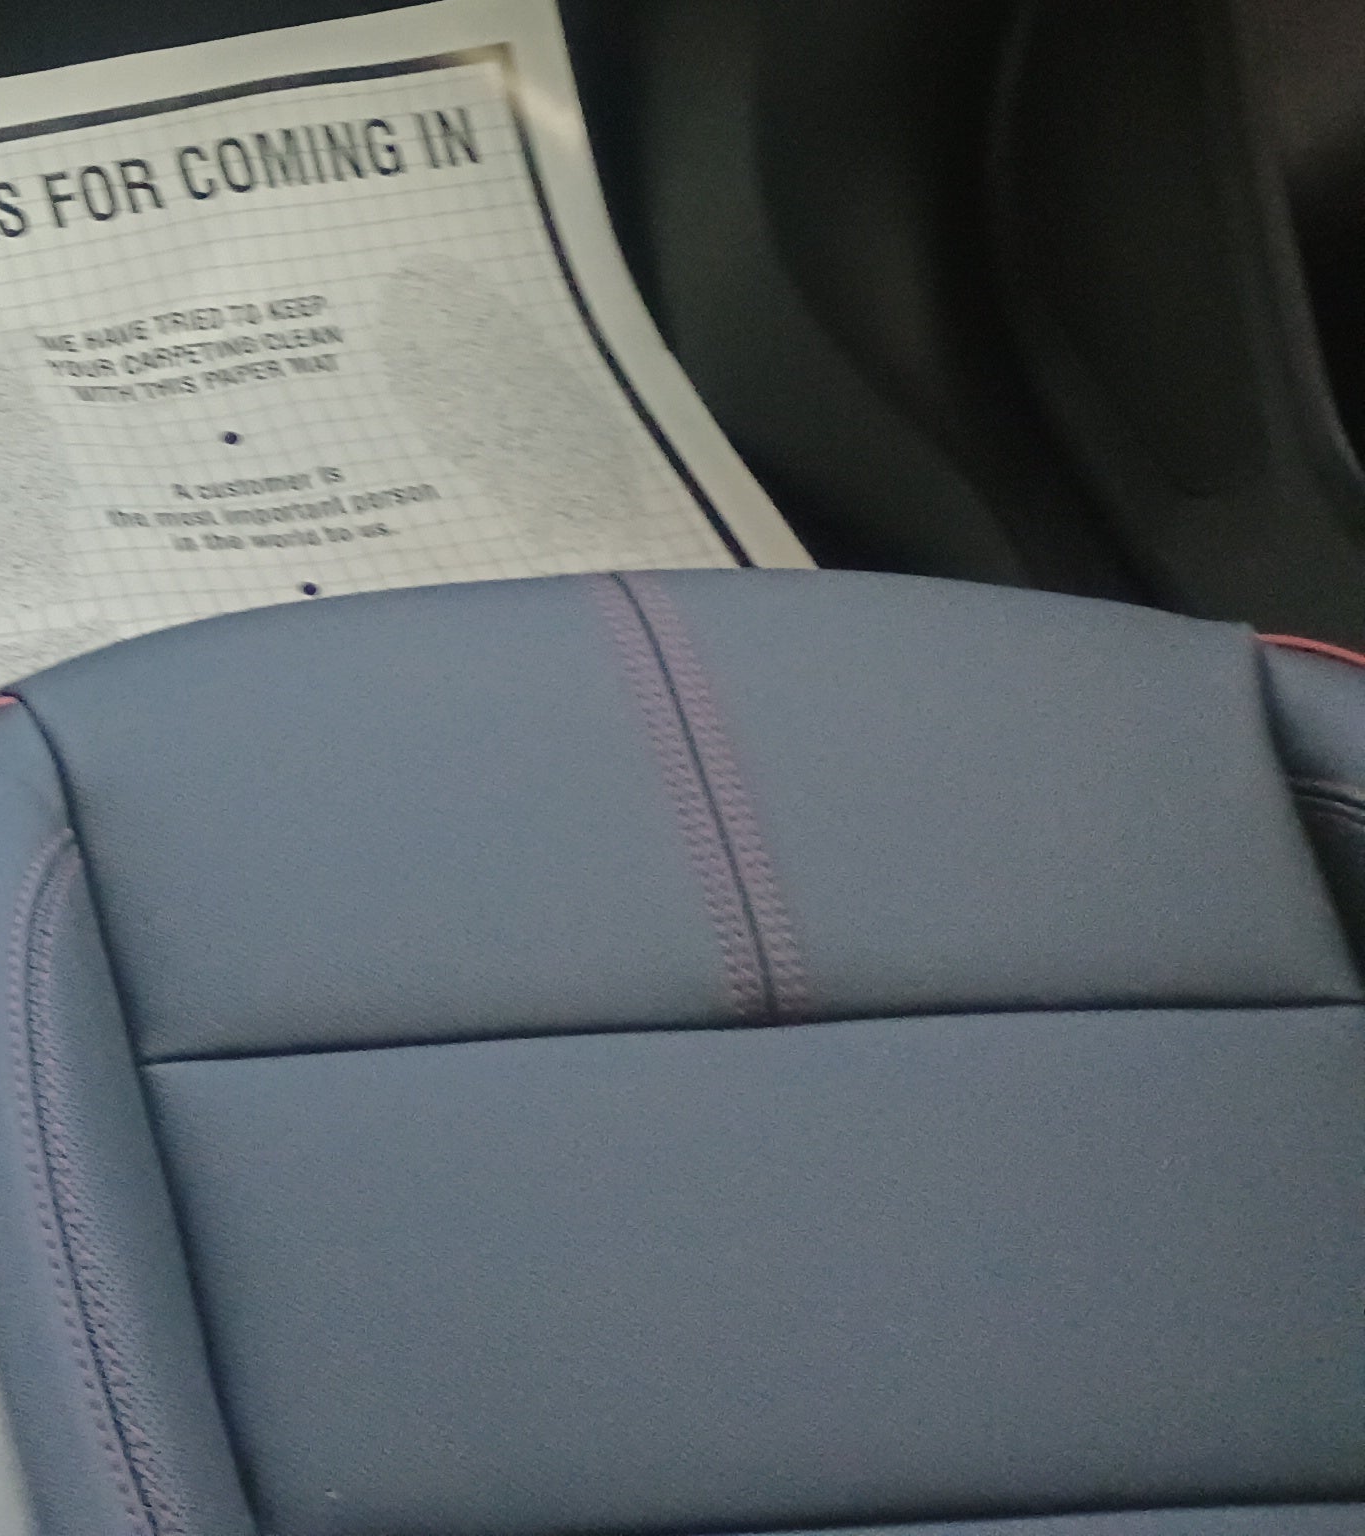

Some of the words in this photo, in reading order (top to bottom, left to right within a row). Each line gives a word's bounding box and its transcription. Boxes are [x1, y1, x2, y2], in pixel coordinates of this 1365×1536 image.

[40, 157, 165, 228] FOR
[175, 117, 405, 201] COMING
[414, 105, 482, 169] IN
[35, 334, 79, 353] WE
[82, 320, 148, 350] HAVE
[153, 307, 222, 334] TRIED
[226, 303, 263, 325] TO
[268, 295, 328, 320] KEEP
[45, 358, 118, 377] YOUR
[122, 336, 260, 374] CARPETING
[259, 325, 344, 350] CLEAN
[72, 385, 138, 402] WITH
[135, 375, 198, 400] THIS
[201, 360, 287, 390] PAPER
[153, 510, 221, 527] most
[222, 496, 348, 525] important
[347, 483, 441, 516] person
[172, 483, 194, 500] A
[196, 473, 314, 500] customer
